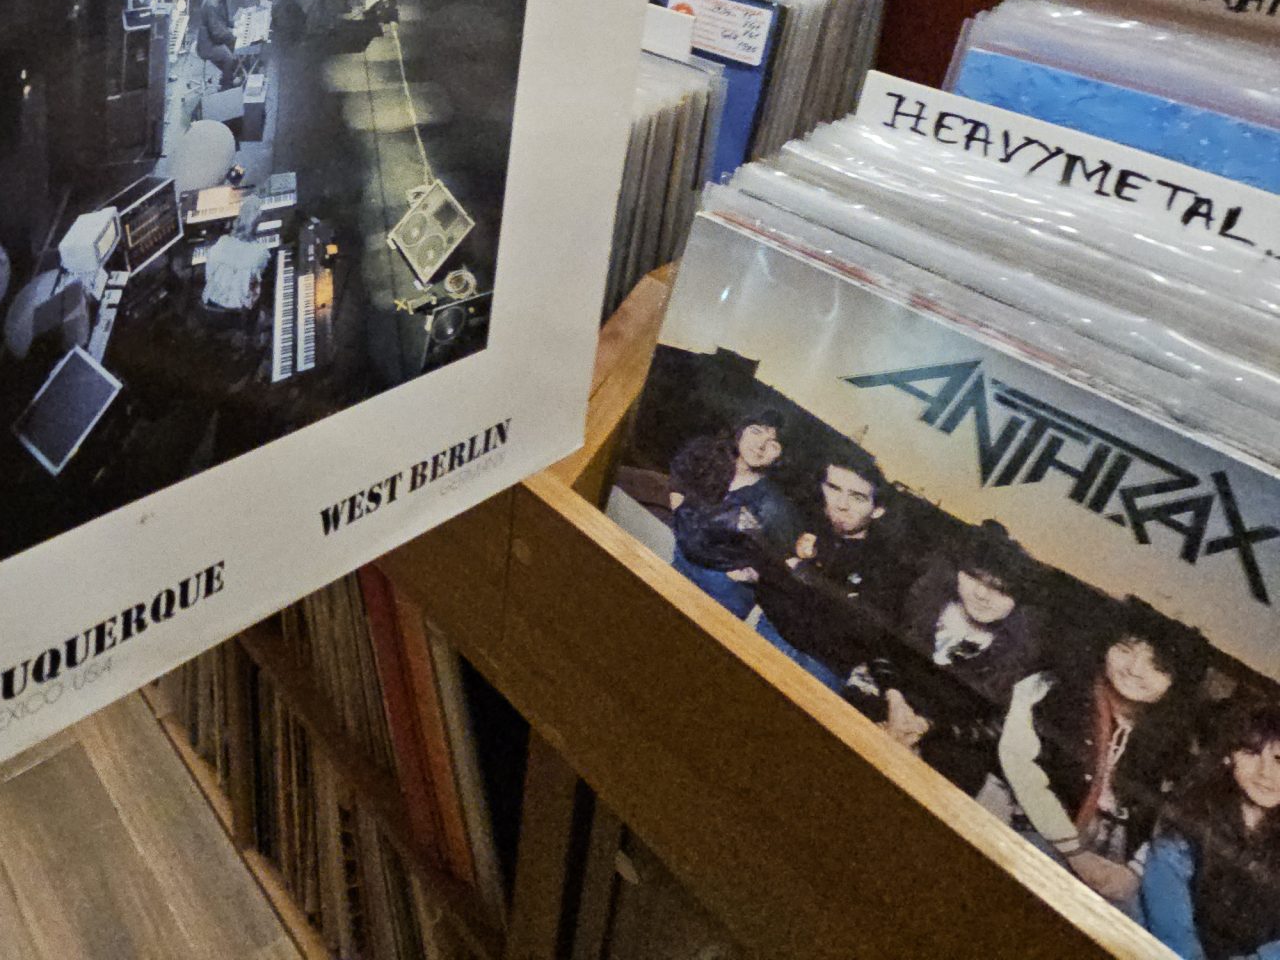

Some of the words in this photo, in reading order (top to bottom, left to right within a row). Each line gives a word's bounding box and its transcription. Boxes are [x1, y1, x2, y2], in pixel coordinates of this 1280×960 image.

[320, 471, 405, 537] WEST
[408, 416, 514, 494] BERLIN
[838, 360, 1280, 607] ANTHRAX
[74, 655, 114, 690] USA
